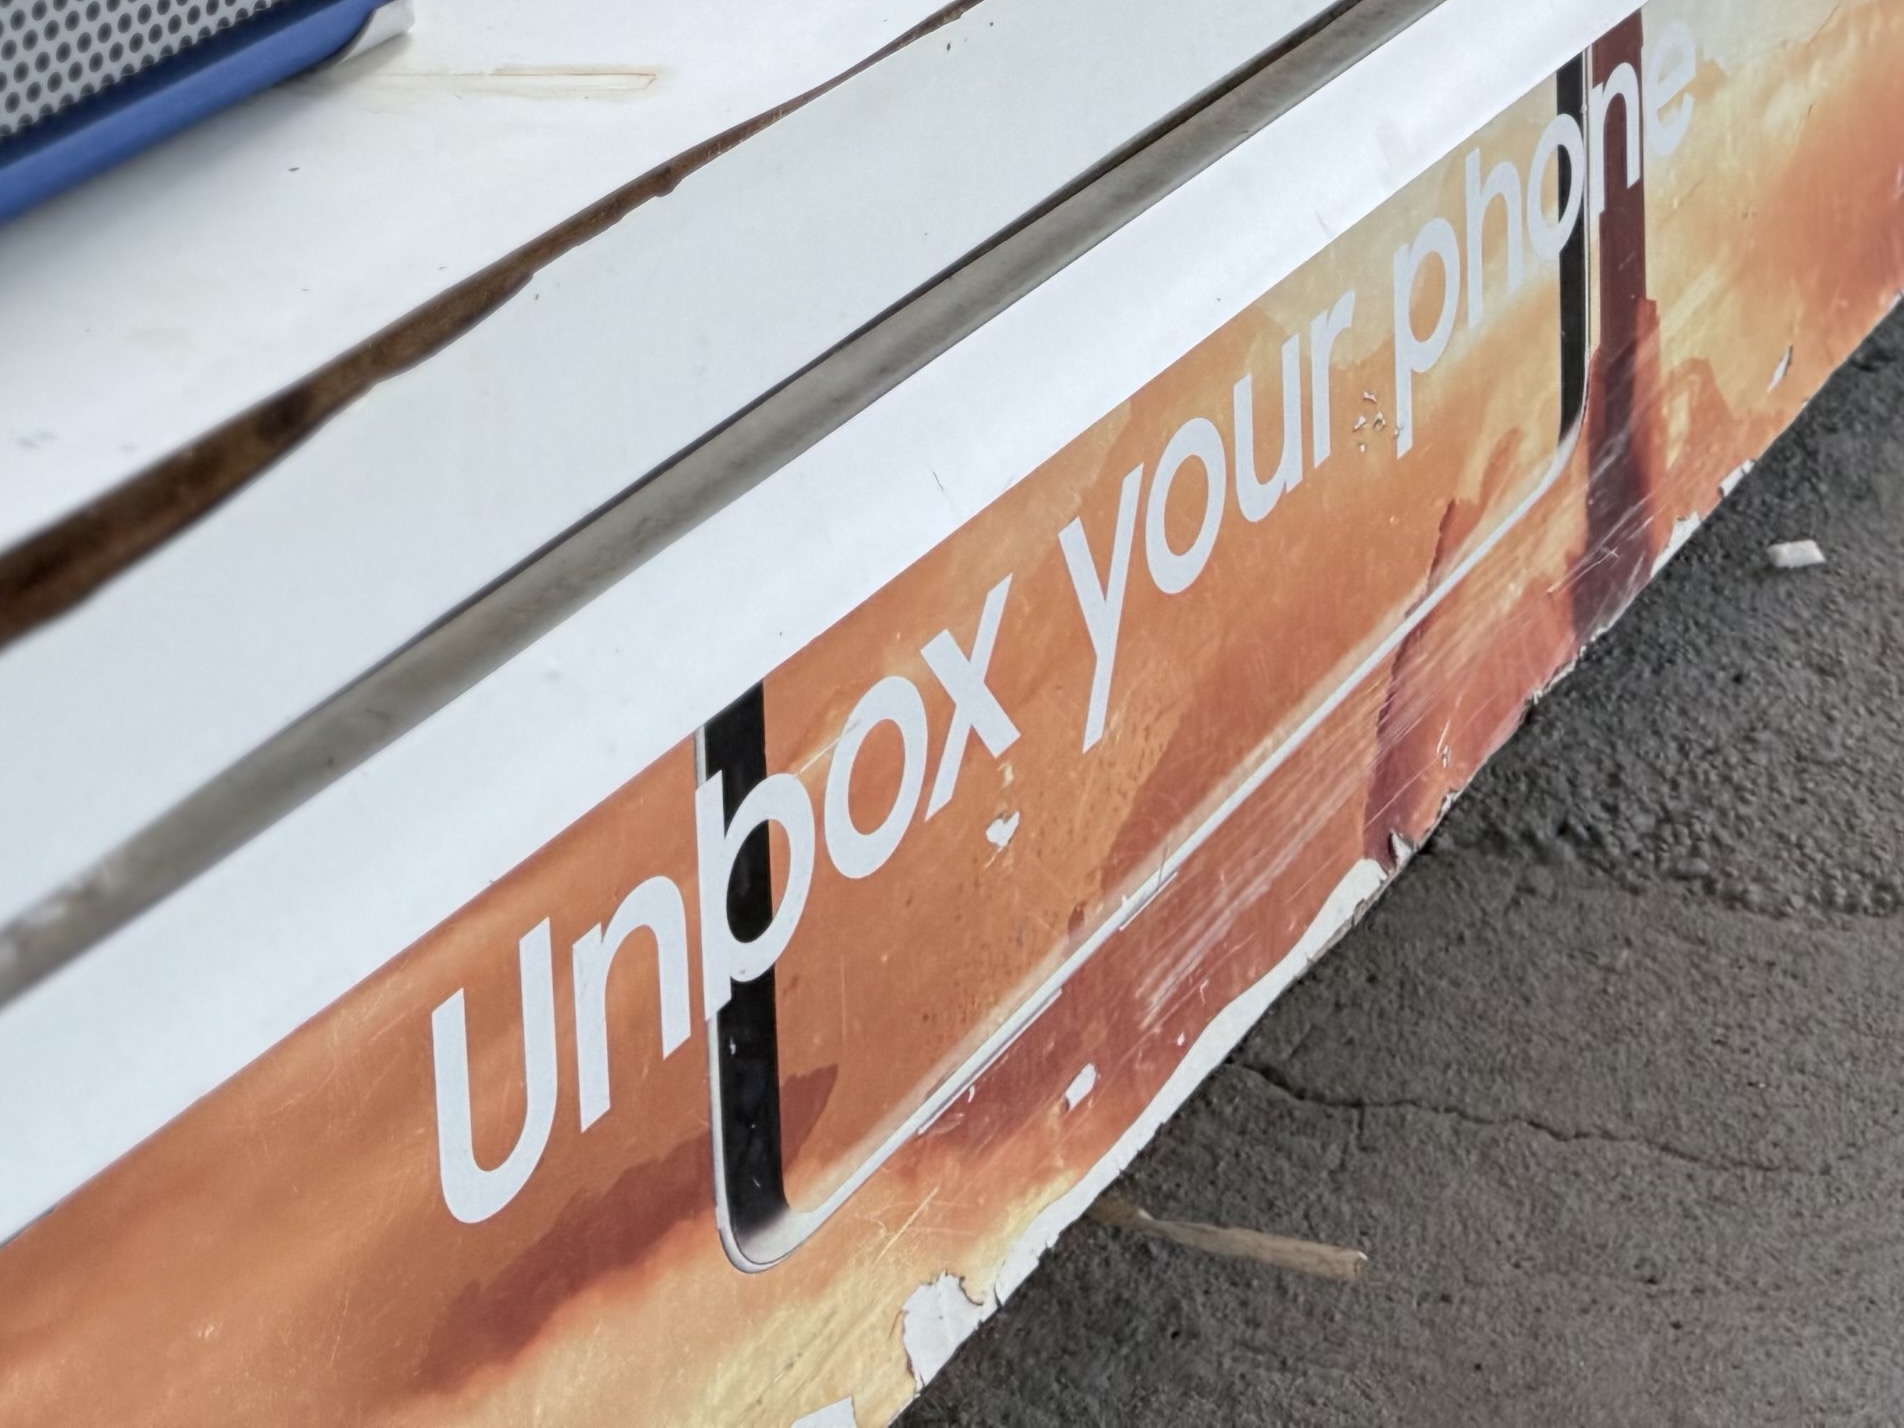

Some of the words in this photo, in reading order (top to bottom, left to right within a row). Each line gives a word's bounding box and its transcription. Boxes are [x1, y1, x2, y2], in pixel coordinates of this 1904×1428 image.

[432, 573, 1021, 1223] Unbox
[1058, 290, 1356, 755] your
[1394, 20, 1696, 460] phone
